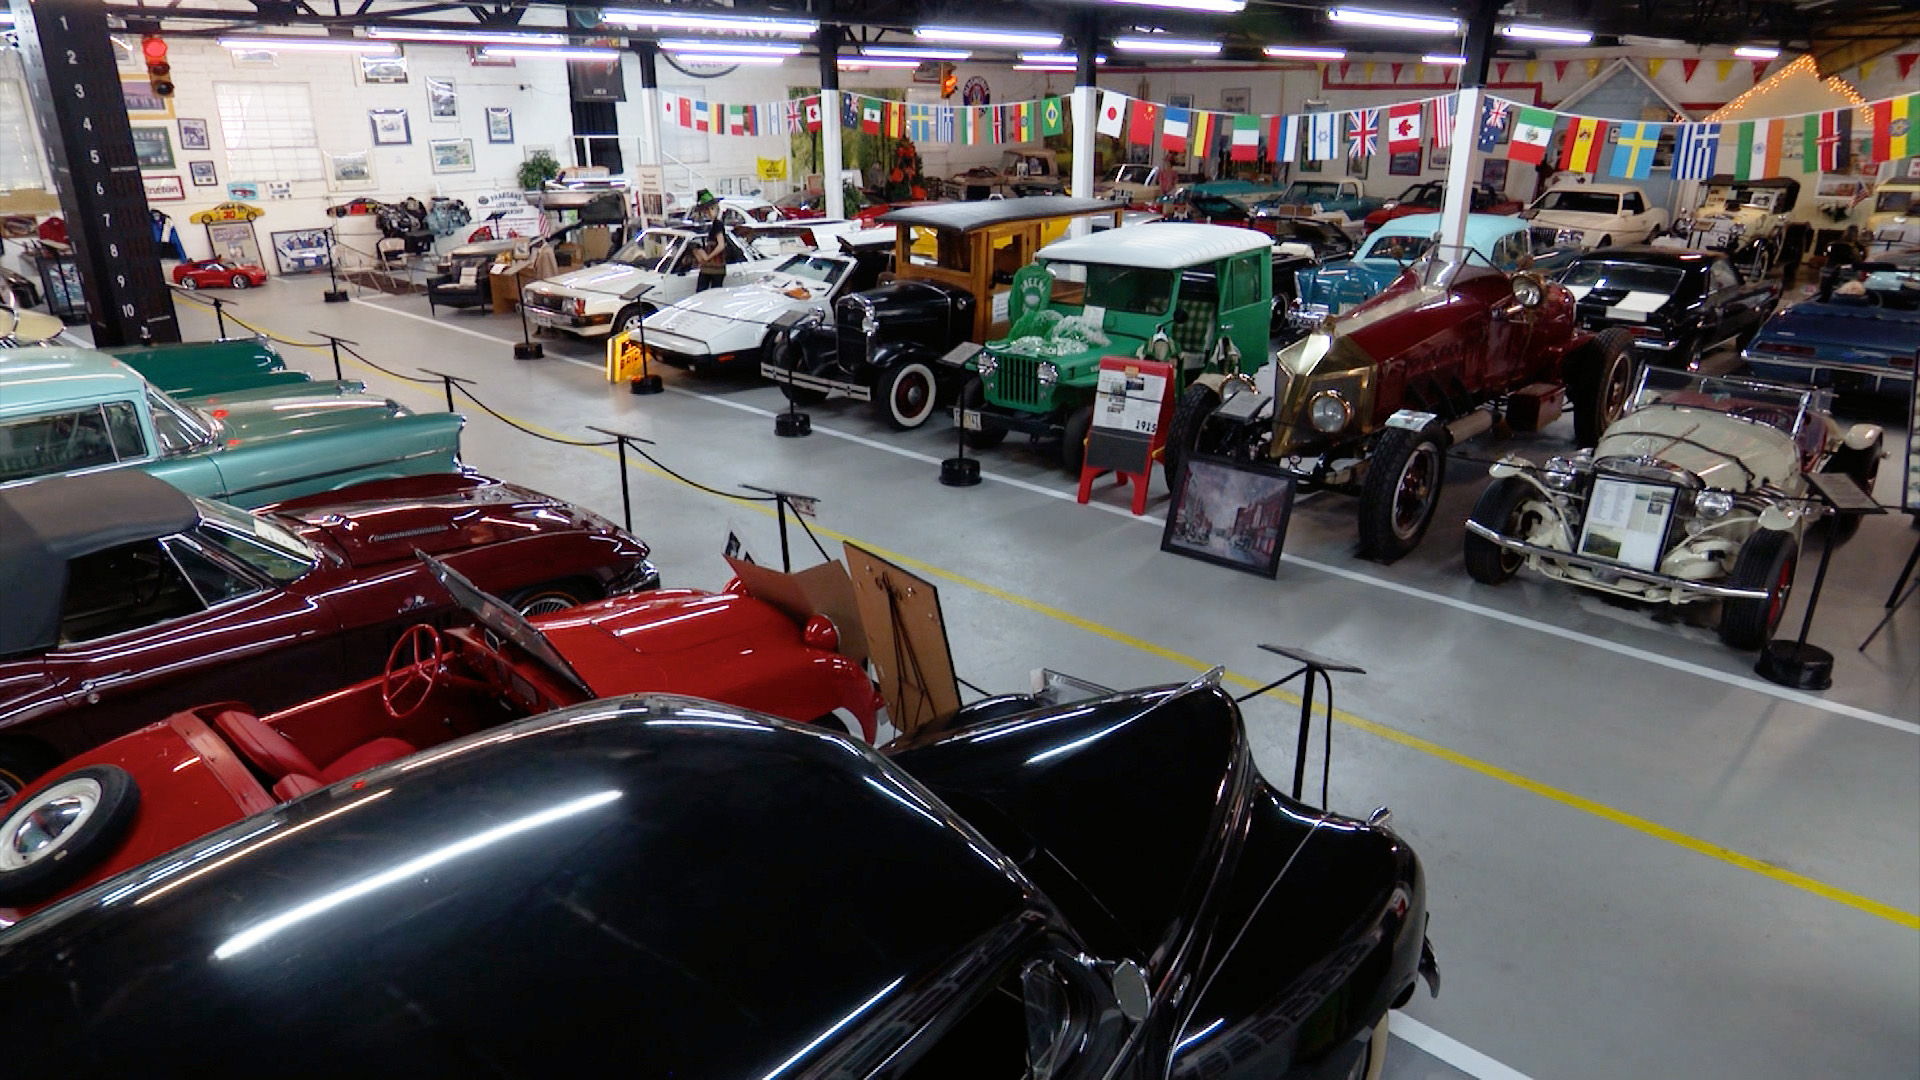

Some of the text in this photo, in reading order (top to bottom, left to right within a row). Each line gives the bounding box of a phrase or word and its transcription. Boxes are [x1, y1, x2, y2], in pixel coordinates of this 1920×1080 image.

[60, 15, 69, 30] 1
[66, 49, 78, 65] 2
[74, 83, 85, 99] 3
[83, 117, 92, 131] 4
[90, 149, 100, 164] 5
[96, 181, 105, 195] 6
[102, 213, 110, 227] 7
[223, 211, 235, 219] 30
[110, 244, 119, 258] 8
[117, 275, 125, 288] 9
[122, 303, 135, 317] 10
[1135, 419, 1157, 433] 1915
